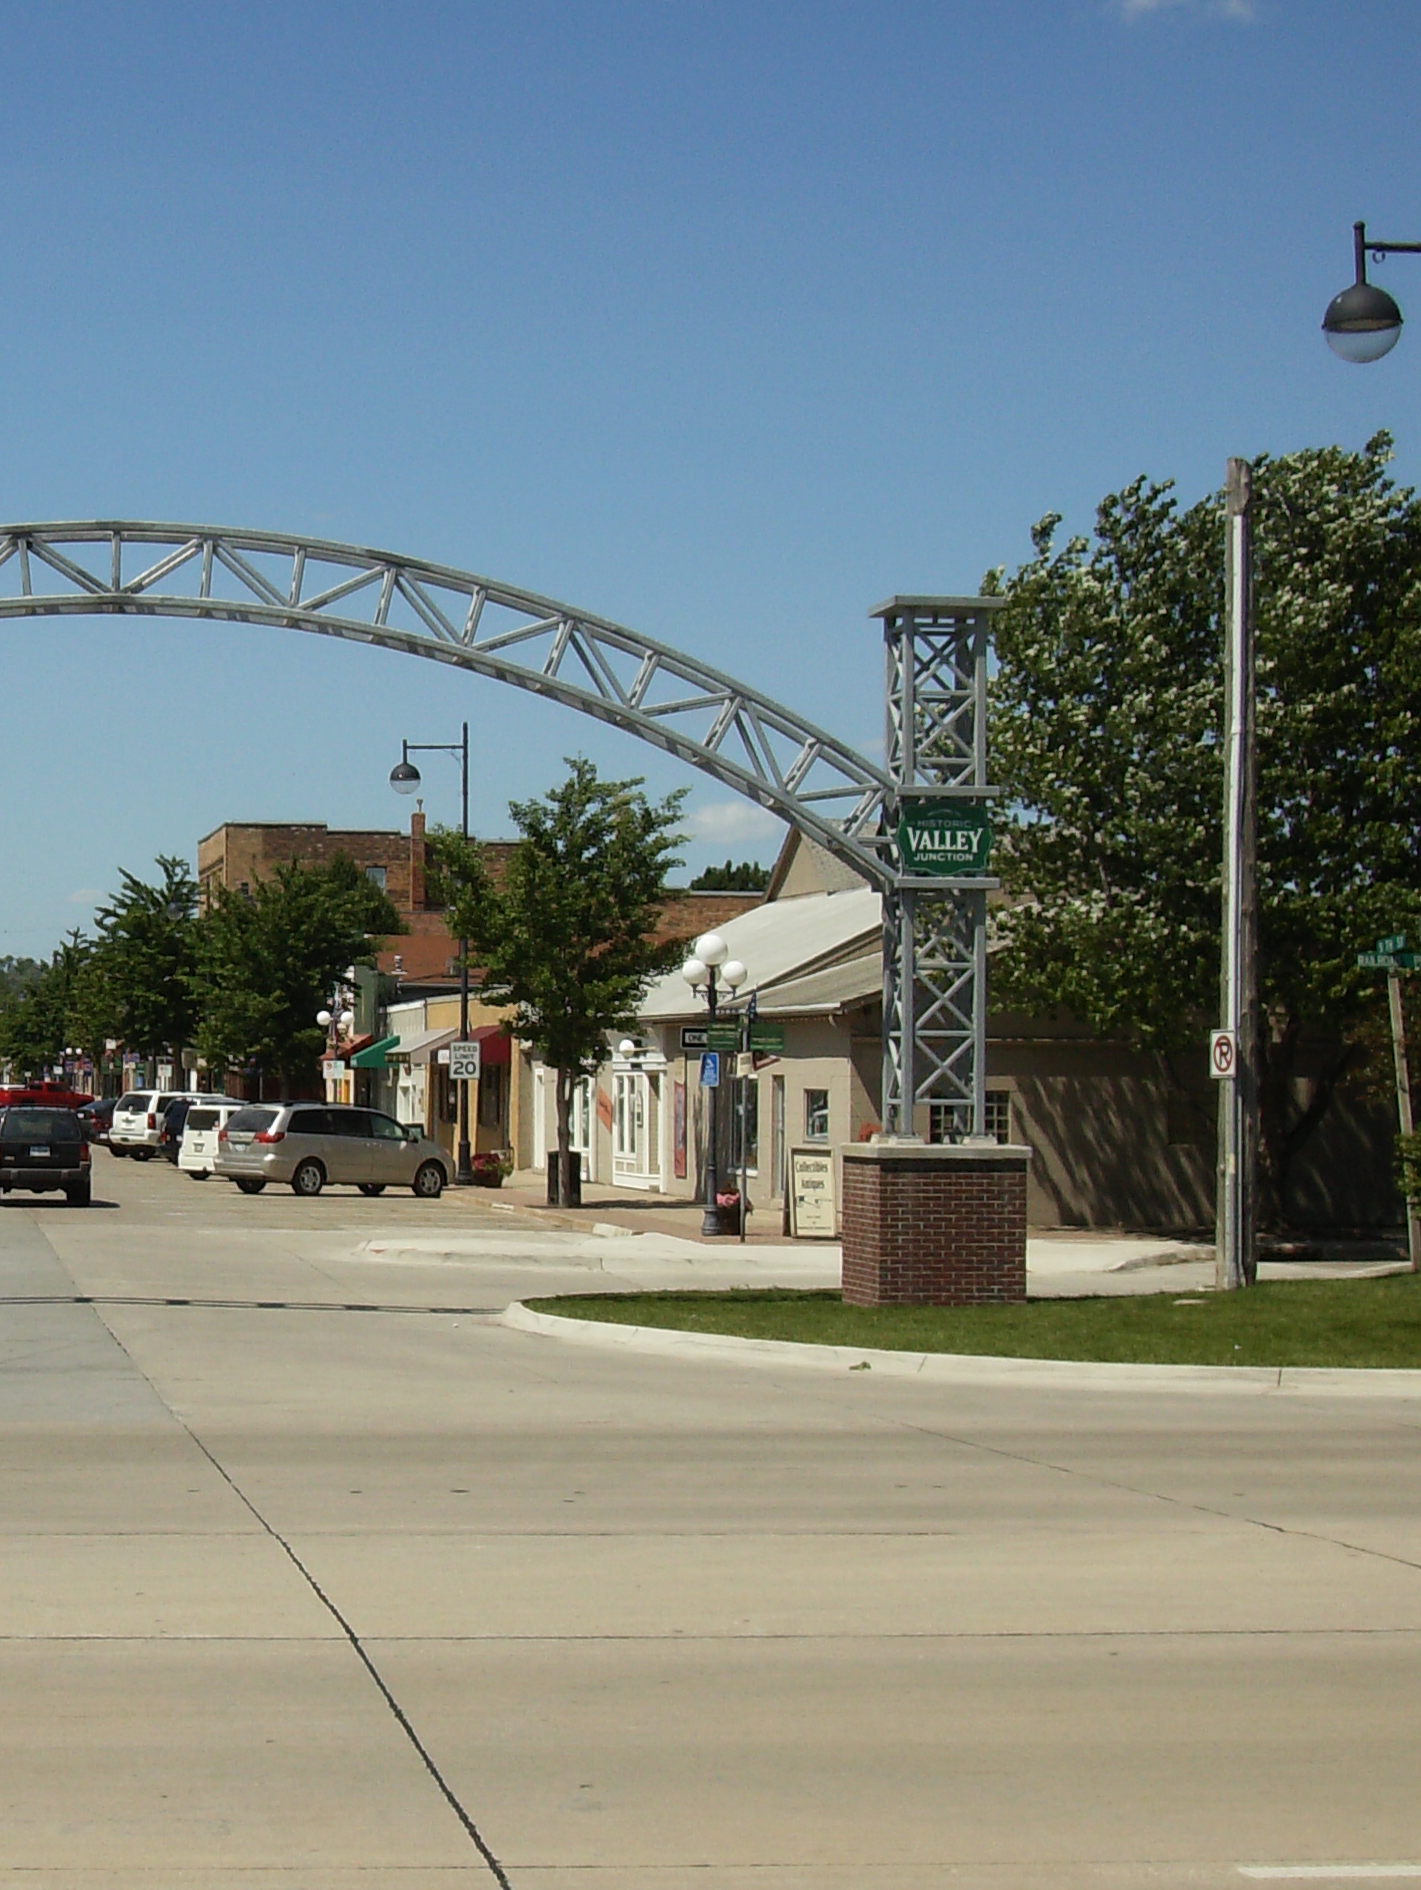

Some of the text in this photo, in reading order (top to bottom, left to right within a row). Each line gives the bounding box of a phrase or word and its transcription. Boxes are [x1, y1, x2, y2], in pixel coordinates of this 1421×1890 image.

[917, 820, 972, 829] HISTORIC
[906, 826, 984, 853] VALLEY
[913, 853, 974, 862] JUNCTION
[453, 1061, 477, 1075] 20
